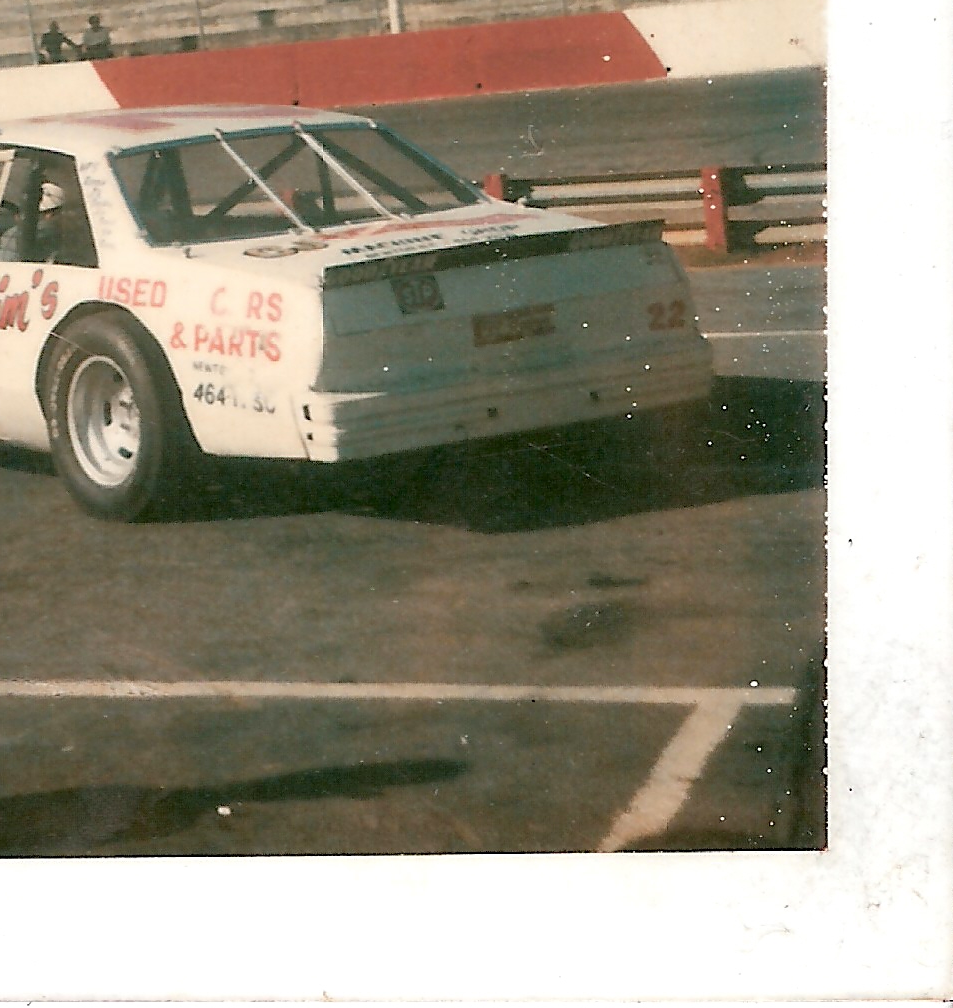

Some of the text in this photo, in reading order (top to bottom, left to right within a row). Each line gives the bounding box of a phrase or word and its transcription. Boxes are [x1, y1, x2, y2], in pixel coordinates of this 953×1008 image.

[97, 275, 168, 309] USED
[647, 299, 686, 331] 22
[170, 321, 282, 362] & PARTS
